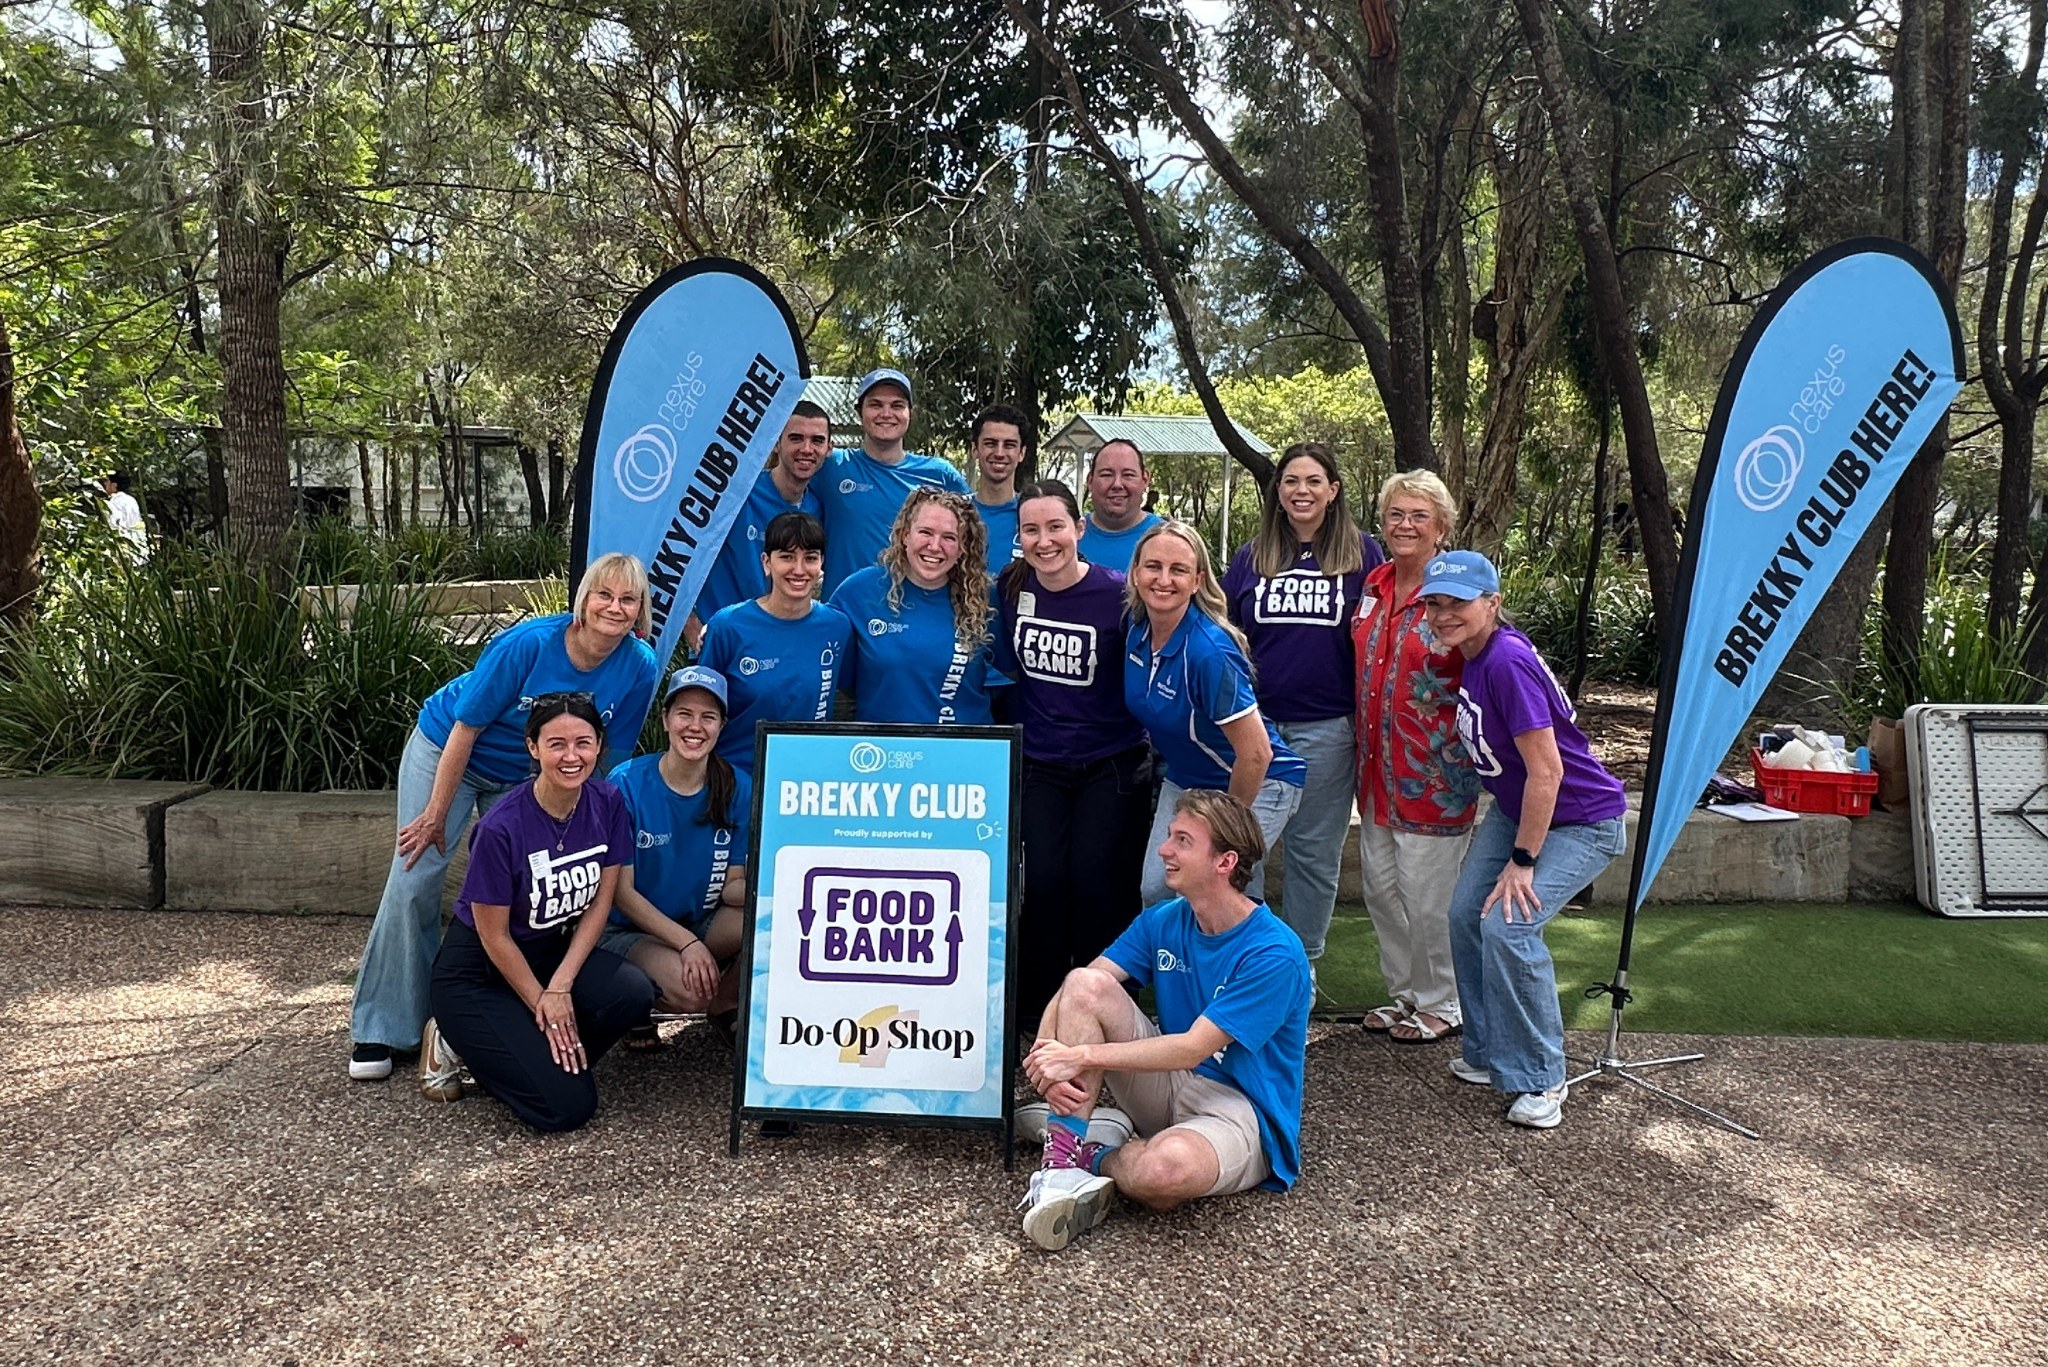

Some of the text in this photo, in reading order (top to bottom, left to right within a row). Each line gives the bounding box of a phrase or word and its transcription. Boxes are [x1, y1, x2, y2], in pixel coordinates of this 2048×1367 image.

[657, 351, 704, 422] nexus
[1789, 343, 1846, 425] nexus
[671, 378, 707, 432] care
[1803, 376, 1846, 434] care
[649, 352, 786, 650] EKKY CLUB HERE!
[1713, 348, 1937, 689] BREKKY CLUB HERE!
[1267, 593, 1330, 614] BANK
[1269, 577, 1331, 594] FOOD
[1023, 628, 1083, 657] FOOD
[1023, 649, 1082, 676] BANK
[814, 669, 833, 721] BREKK
[938, 706, 956, 724] CL
[887, 750, 923, 761] nexus
[887, 759, 914, 769] care
[779, 780, 986, 819] BREKKY CLUB
[834, 828, 933, 840] Proudly supported by
[545, 861, 601, 898] FOOD
[702, 849, 729, 909] BREKKY
[826, 888, 935, 926] FOOD
[824, 926, 935, 964] BANK
[779, 1016, 975, 1059] Do-Op Shop
